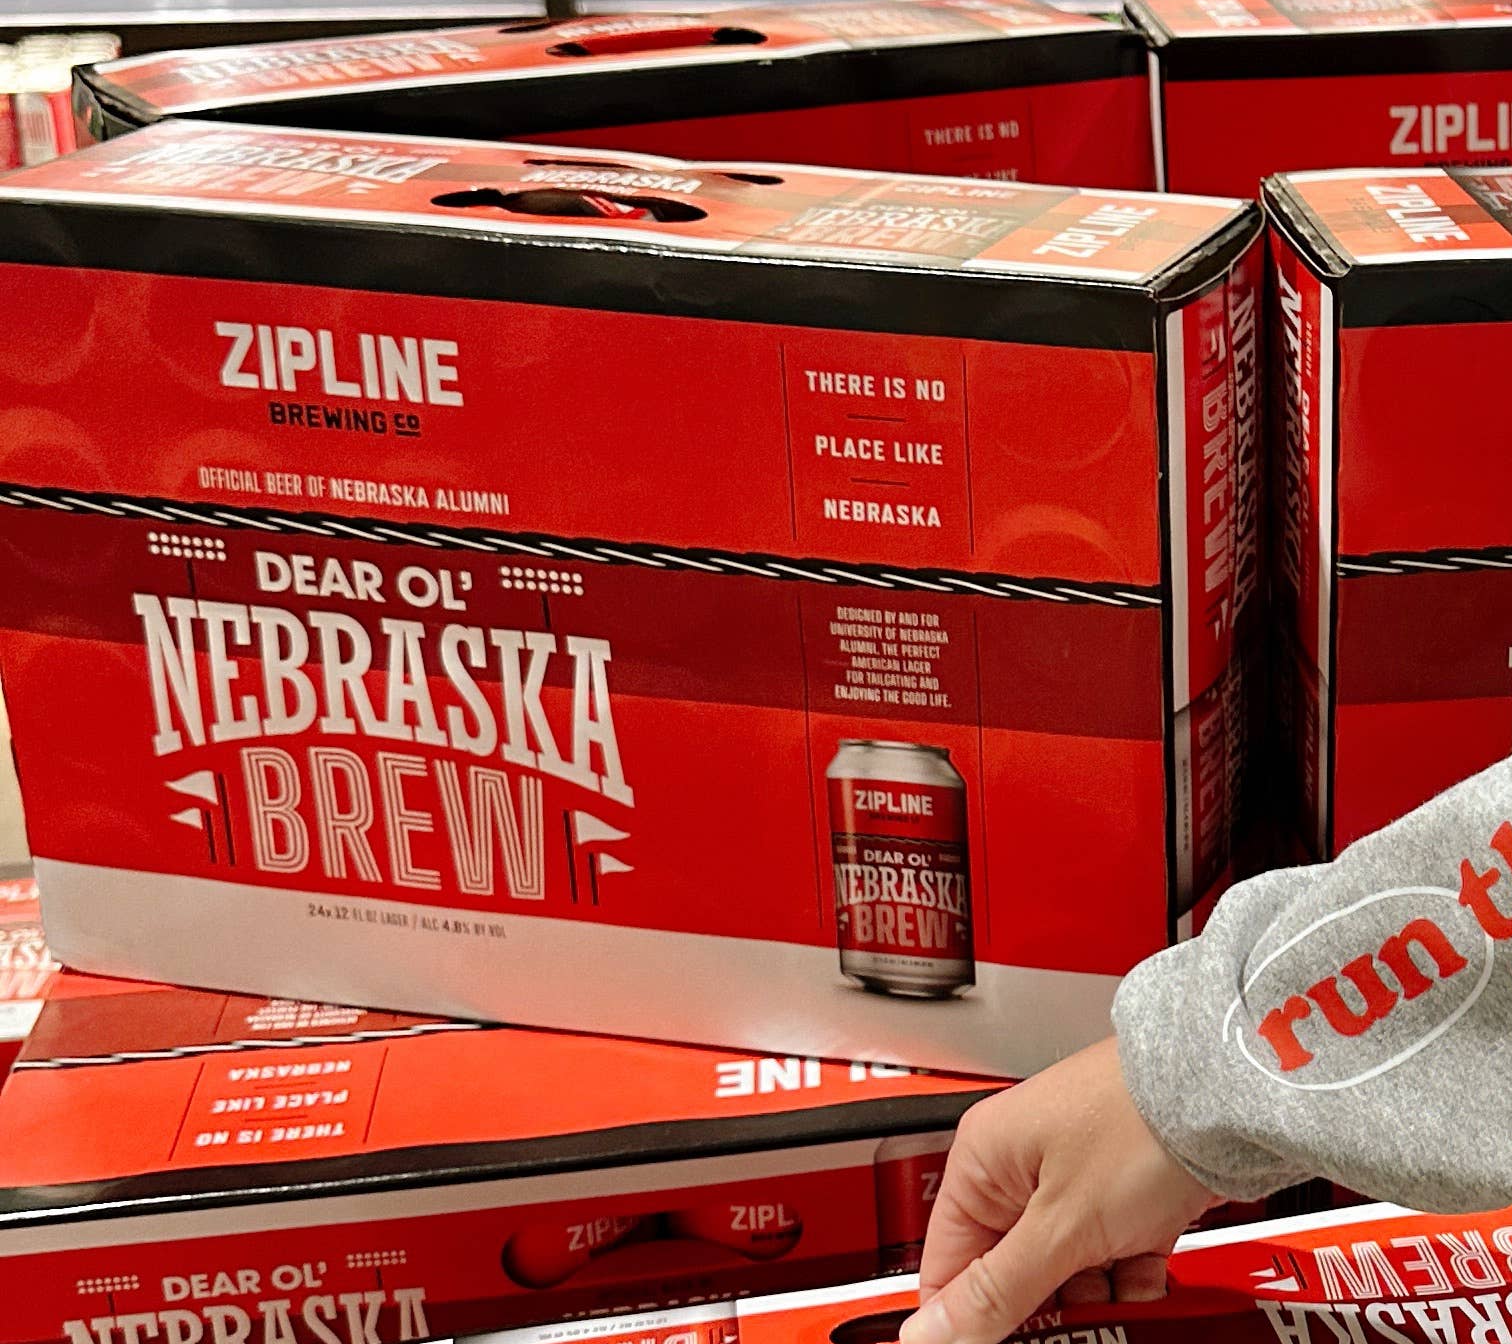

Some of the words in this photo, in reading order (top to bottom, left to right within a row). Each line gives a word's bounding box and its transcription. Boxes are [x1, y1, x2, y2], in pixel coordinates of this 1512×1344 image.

[924, 124, 974, 146] THERE
[1365, 183, 1473, 244] ZIPLINE
[1032, 204, 1160, 258] ZIPLINE
[214, 320, 465, 407] ZIPLINE
[804, 370, 876, 398] THERE
[885, 377, 906, 399] IS
[915, 379, 947, 402] NO
[268, 401, 388, 434] BREWING
[814, 434, 885, 462] PLACE
[893, 442, 944, 465] LIKE
[199, 466, 262, 495] OFFICIAL
[266, 471, 303, 498] BEER
[330, 477, 430, 510] NEBRASKA
[436, 486, 510, 516] ALUMNI
[823, 498, 942, 528] NEBRASKA
[255, 550, 387, 604] DEAR
[837, 606, 883, 626] DESIGNED
[899, 611, 920, 627] AND
[921, 612, 940, 628] FOR
[830, 622, 884, 641] UNIVERSITY
[900, 628, 949, 645] NEBRASKA
[851, 655, 901, 673] AMERICAN
[902, 658, 932, 675] LAGER
[882, 642, 899, 658] THE
[901, 644, 941, 660] PERFECT
[132, 592, 635, 809] NEBRASKA
[835, 683, 881, 704] ENJOYING
[883, 688, 900, 704] THE
[902, 690, 928, 706] GOOD
[854, 789, 933, 817] ZIPLINE
[239, 746, 546, 902] BREW
[864, 847, 904, 866] DEAR
[854, 904, 948, 950] BREW
[1257, 917, 1469, 1073] run
[162, 1268, 262, 1303] DEAR
